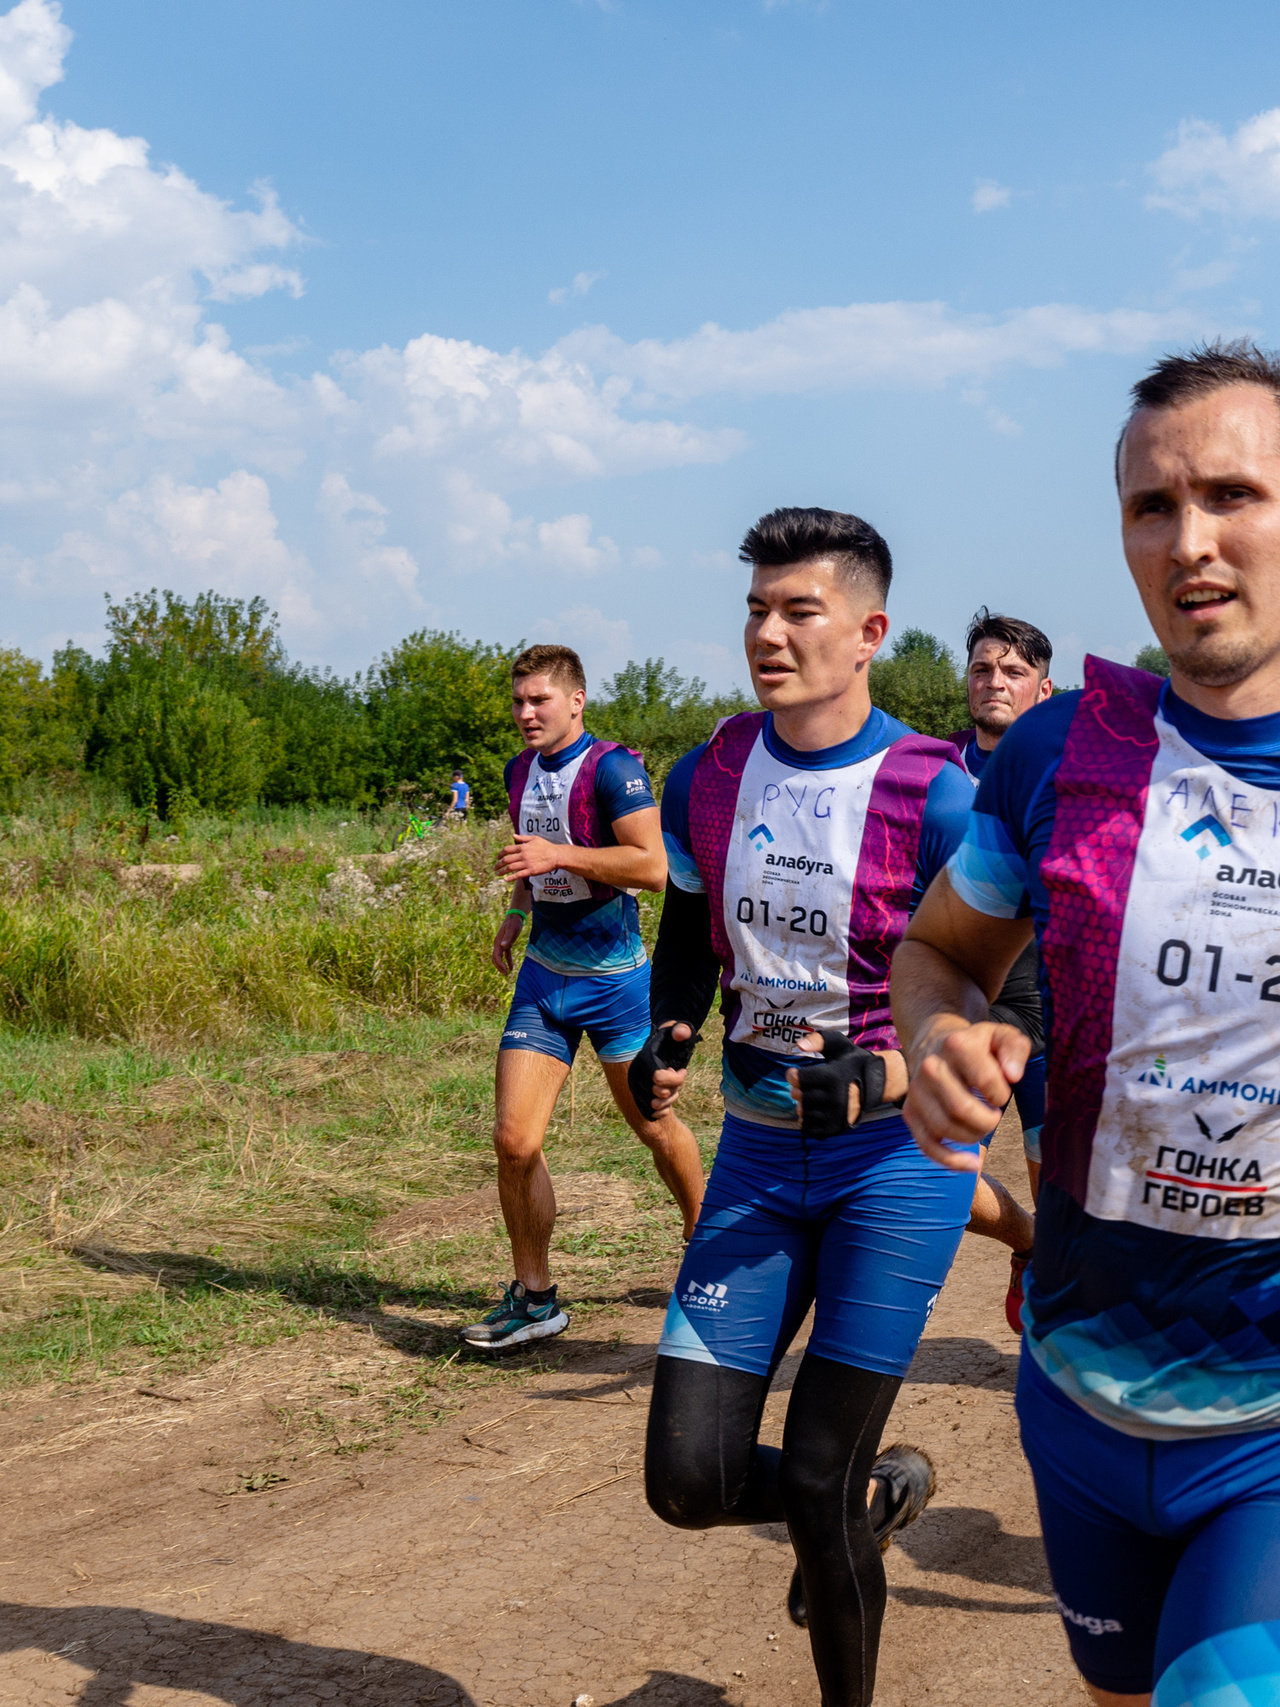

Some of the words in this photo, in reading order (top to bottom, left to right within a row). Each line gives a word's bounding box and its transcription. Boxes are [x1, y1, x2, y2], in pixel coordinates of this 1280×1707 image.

[526, 817, 560, 833] 01-20
[765, 853, 834, 876] алабуга
[1212, 891, 1246, 902] ОСОБАЯ
[736, 896, 828, 937] 01-20
[1210, 909, 1232, 918] ЗОНА
[756, 976, 828, 992] АММОНИЙ
[753, 1012, 810, 1027] ГОНКА
[1155, 1145, 1263, 1183] ГОНКА
[1143, 1181, 1266, 1218] ГЕРОЕВ
[681, 1294, 729, 1309] SPORT
